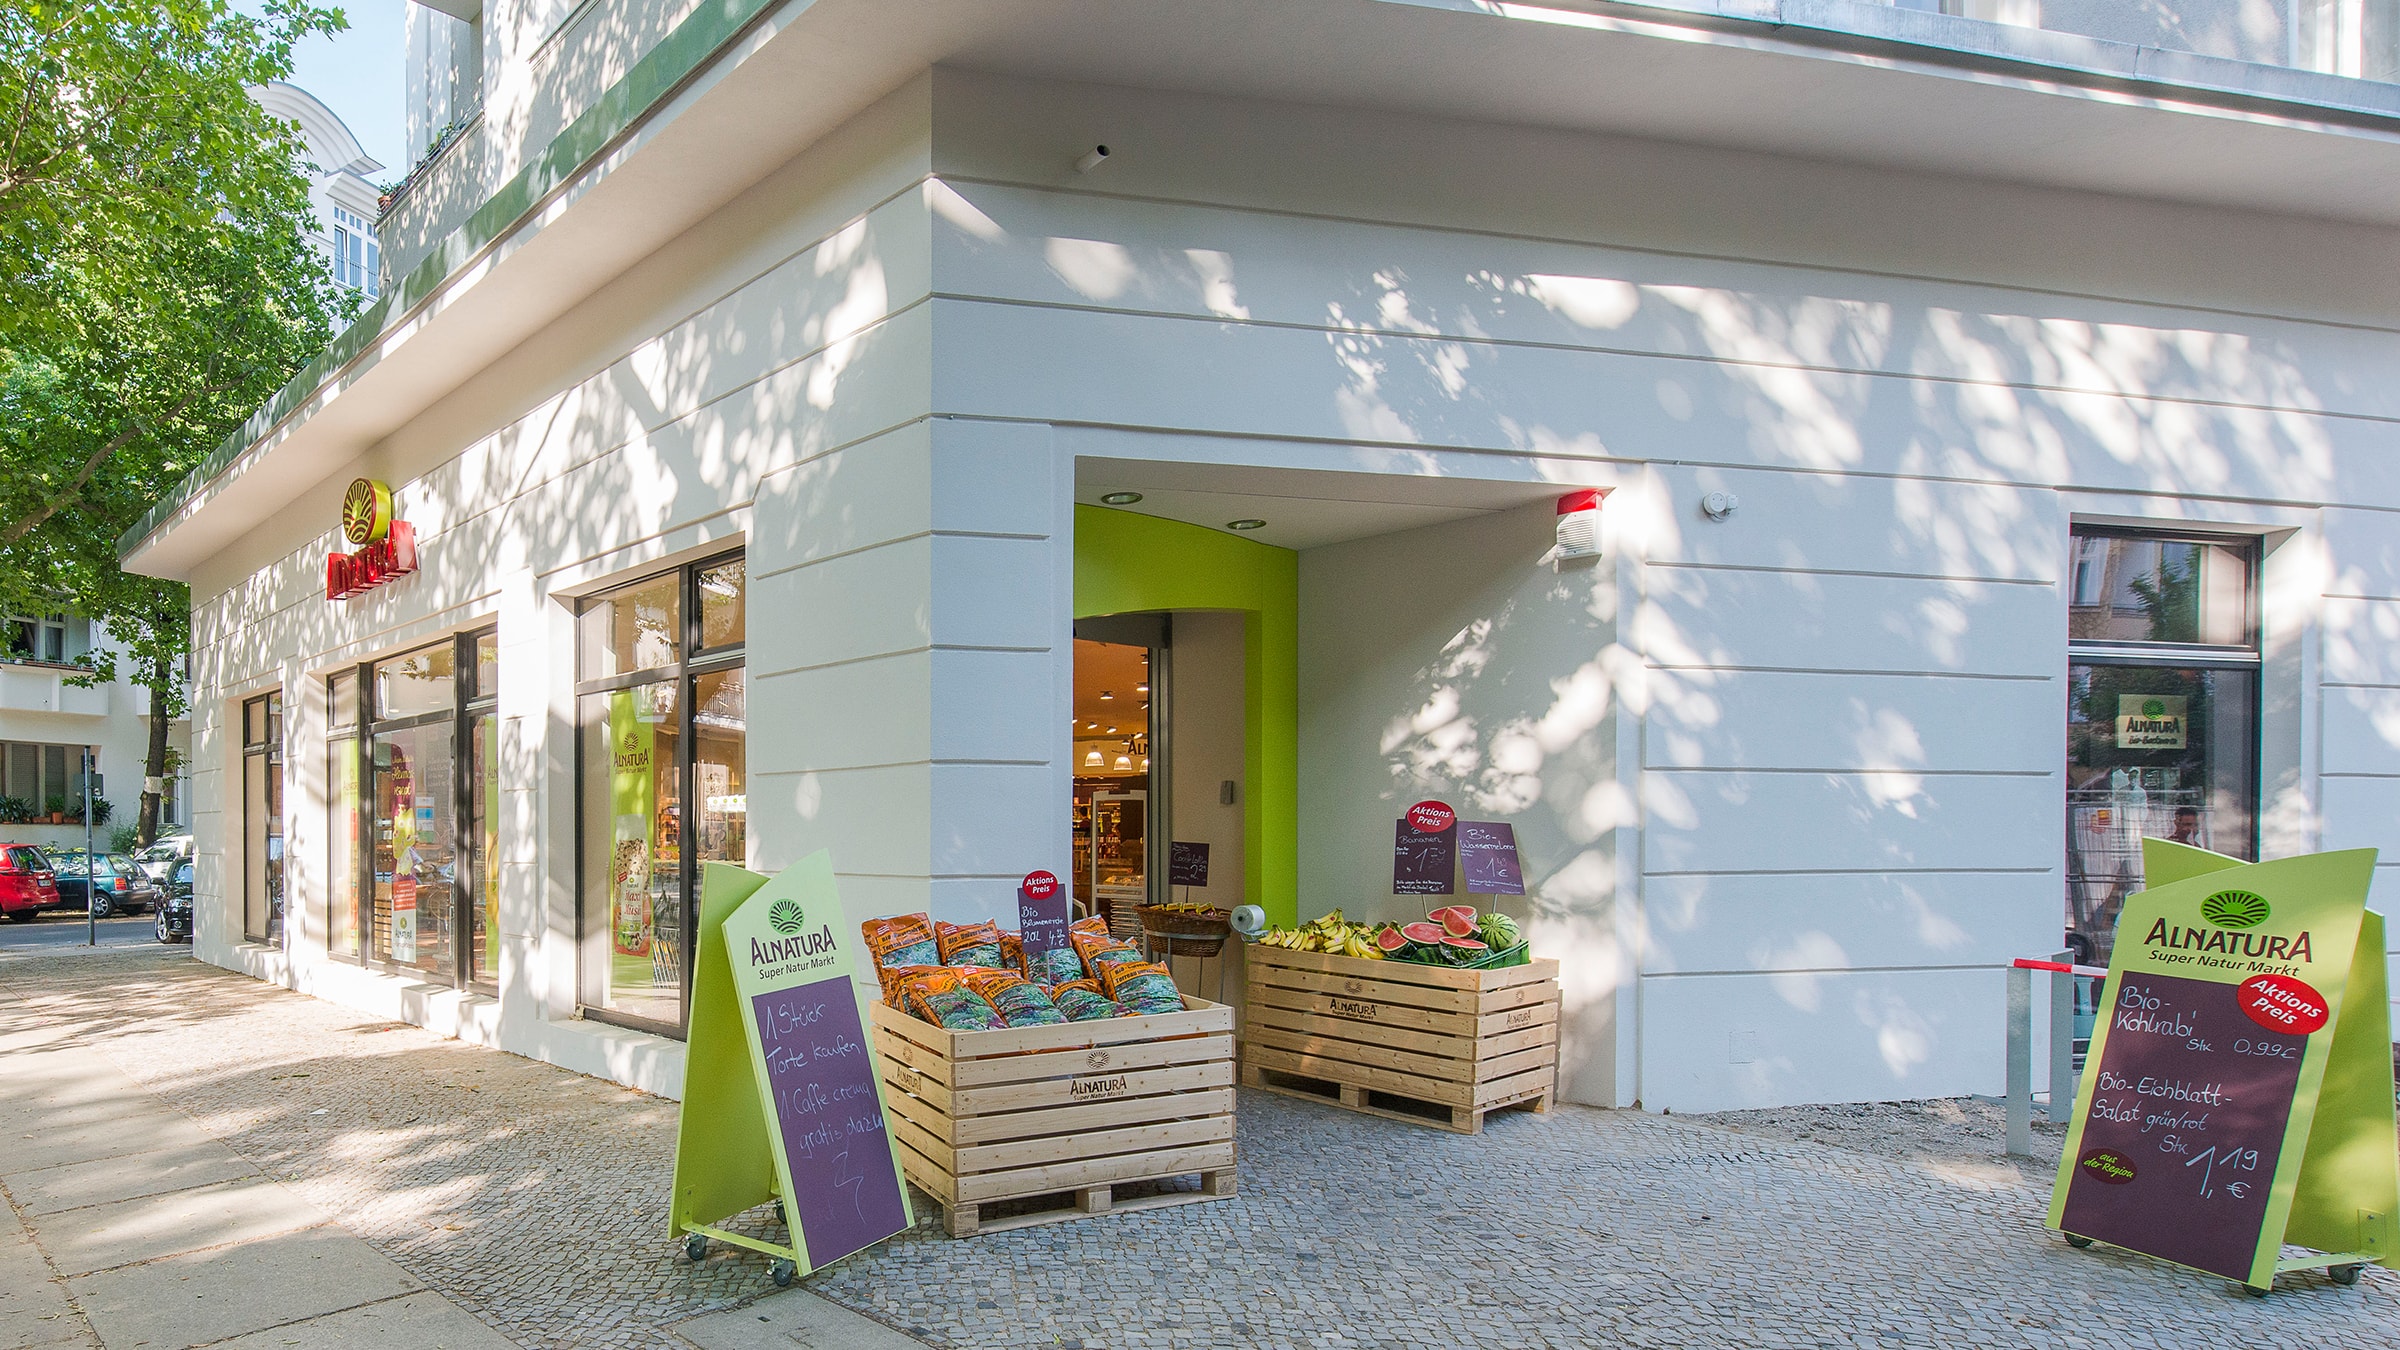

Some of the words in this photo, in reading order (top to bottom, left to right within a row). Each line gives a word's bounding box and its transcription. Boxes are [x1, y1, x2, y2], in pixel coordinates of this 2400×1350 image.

[2126, 717, 2180, 733] ALNATURA
[614, 748, 649, 767] ALNATURA
[1412, 806, 1451, 818] Aktions
[1417, 816, 1441, 826] Preis
[1026, 877, 1054, 886] Aktions
[1032, 885, 1050, 893] Preis
[1021, 905, 1038, 918] Bio
[751, 924, 837, 967] ALNATURA
[2144, 917, 2312, 963] ALNATURA
[759, 967, 785, 980] Super
[785, 962, 810, 974] Natur
[810, 956, 835, 969] Markt
[2148, 949, 2194, 965] Super
[2197, 955, 2244, 971] Natur
[2247, 961, 2299, 977] Markt
[1330, 998, 1376, 1016] ALNATURA
[2119, 985, 2171, 1011] Bio-
[2250, 979, 2322, 1018] Aktions
[779, 1001, 826, 1034] Stück
[2116, 1010, 2197, 1037] Kohlrabi
[2251, 997, 2298, 1025] Preis
[766, 1046, 809, 1076] Torte
[896, 1065, 922, 1092] ALNATURA
[1070, 1074, 1128, 1095] ALNATURA
[2092, 1098, 2142, 1123] Salat
[2141, 1110, 2209, 1133] grün/rot
[799, 1121, 842, 1159] gratis
[846, 1113, 884, 1136] dazu
[2083, 1159, 2102, 1169] der
[2102, 1162, 2135, 1178] Region
[2099, 1153, 2118, 1164] aus
